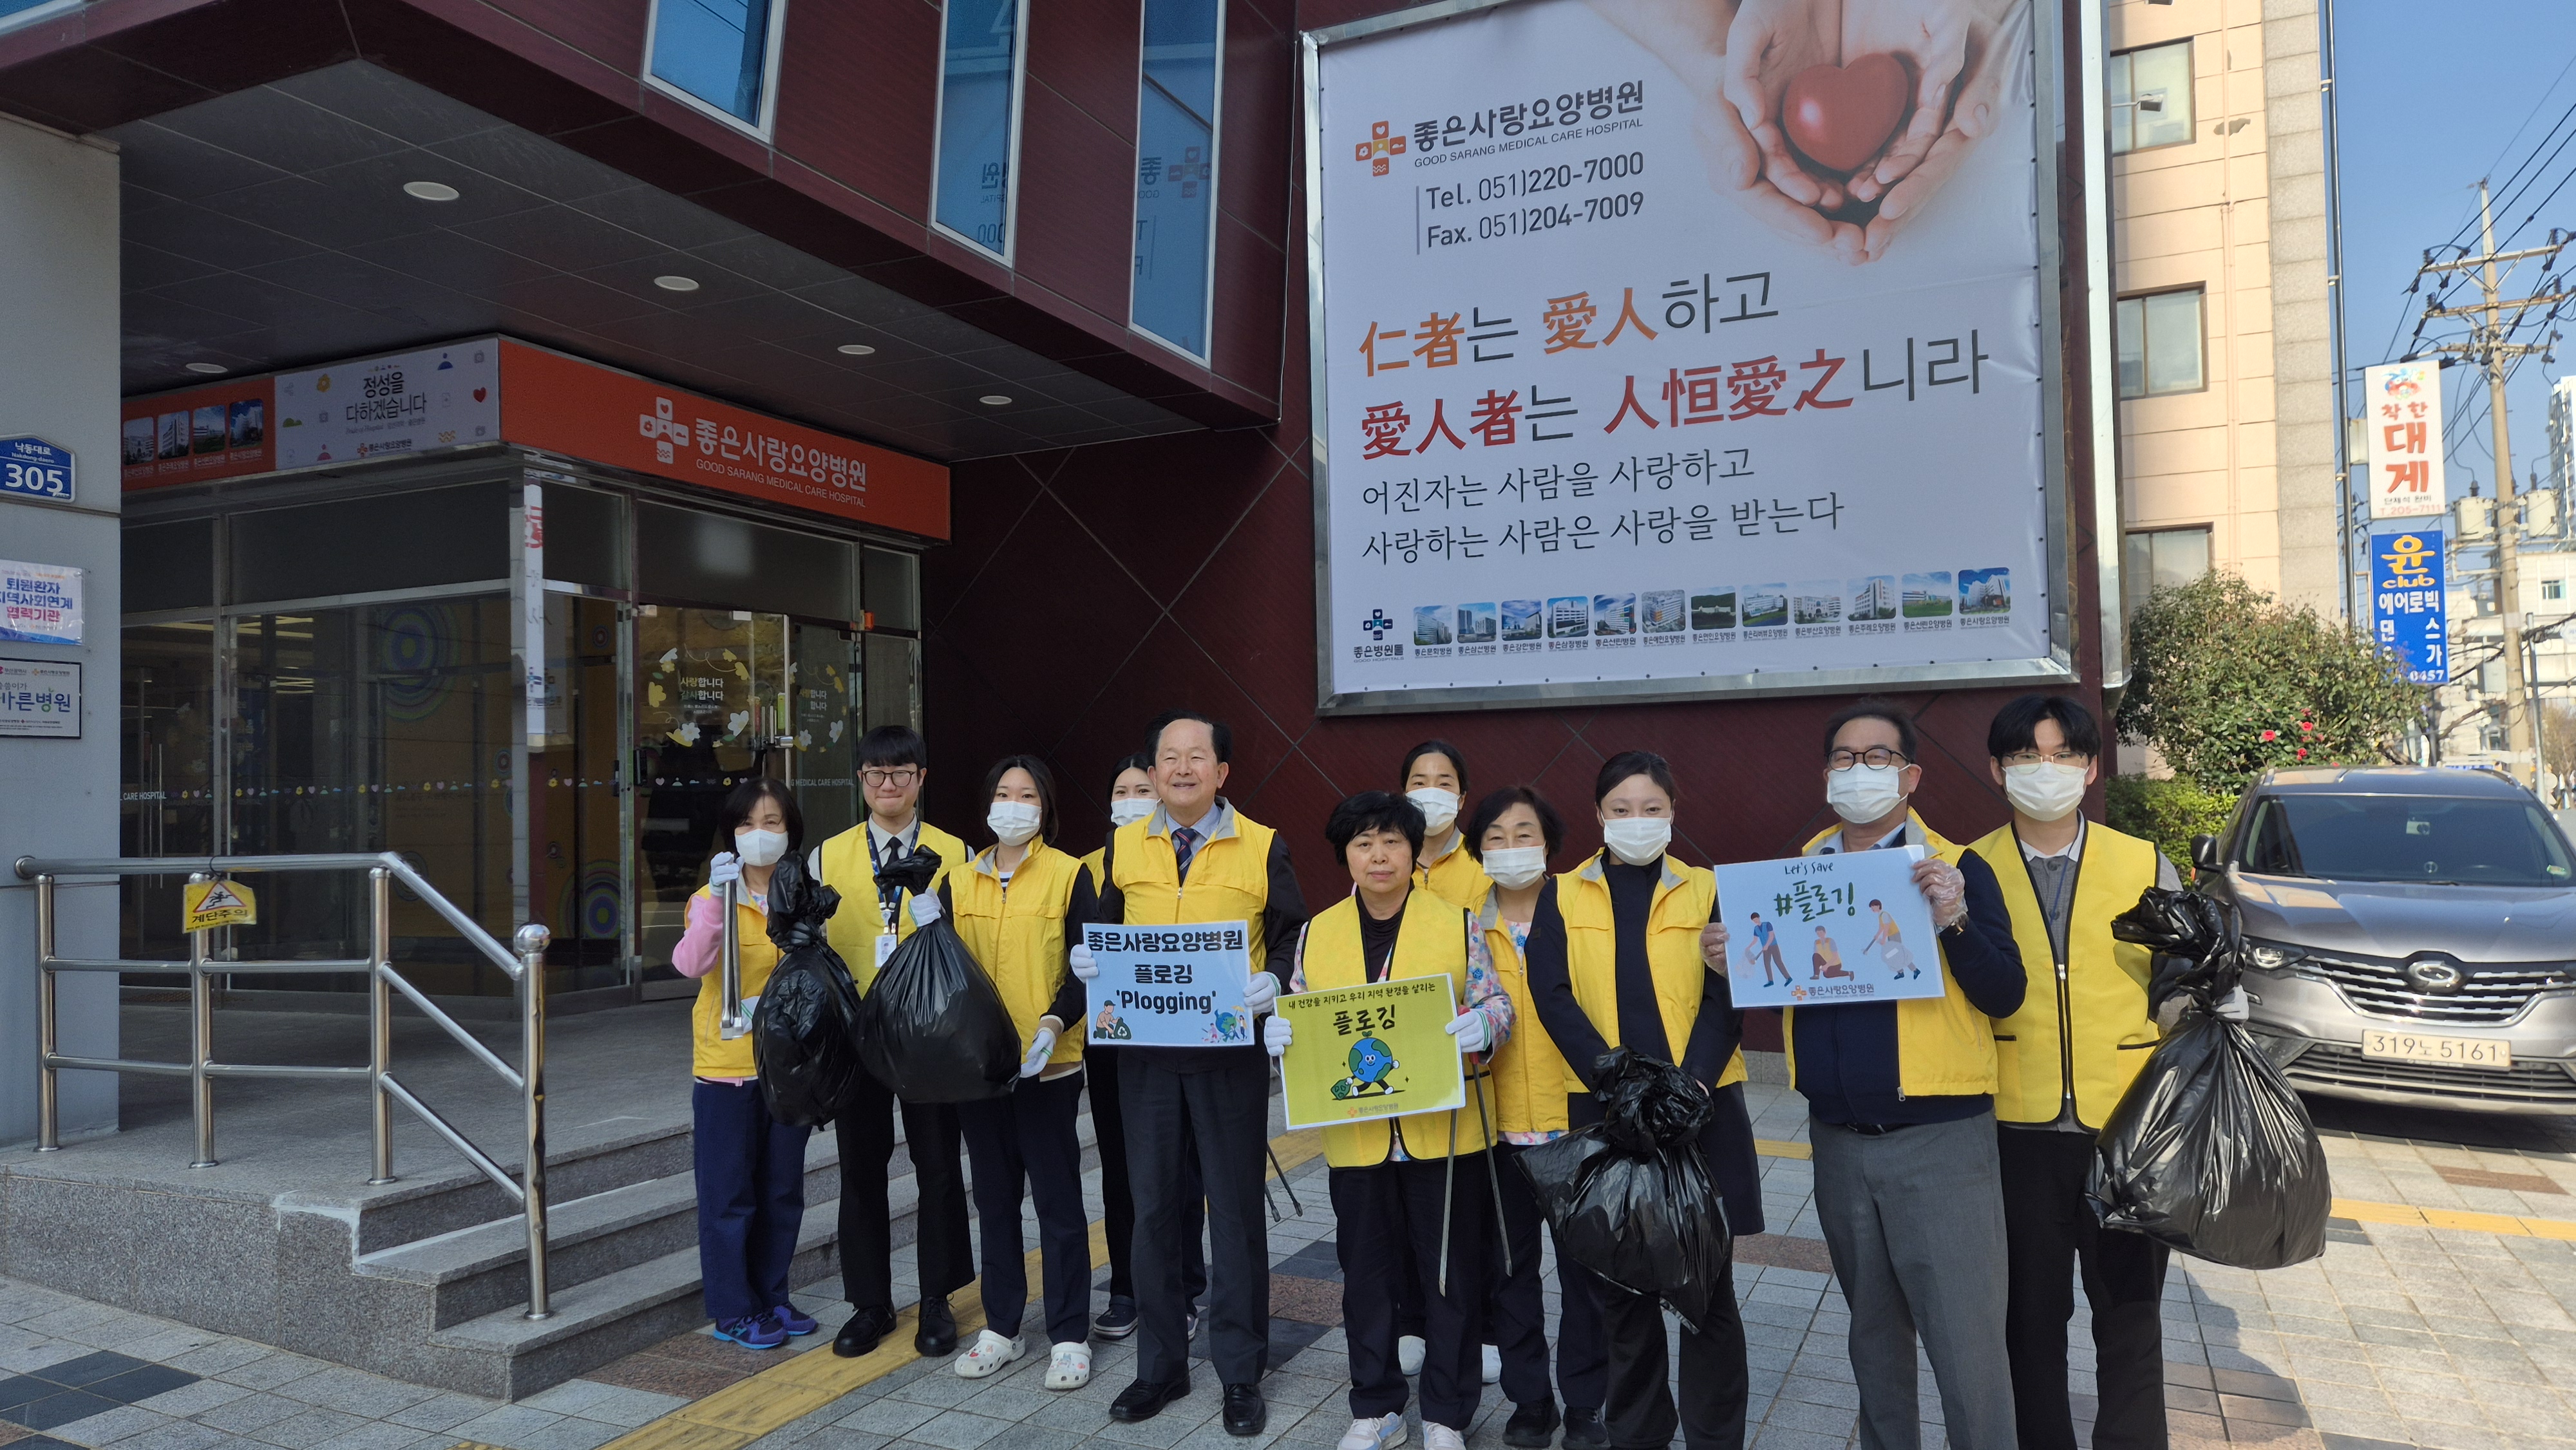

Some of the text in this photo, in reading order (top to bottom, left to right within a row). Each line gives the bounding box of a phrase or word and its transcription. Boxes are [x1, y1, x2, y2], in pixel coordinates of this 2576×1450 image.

[1414, 79, 1643, 152] 좋은사랑요양병원
[1414, 118, 1643, 167] GOOD SARANG MEDICAL CARE HOSPITAL
[1426, 152, 1643, 210] Tel. 051)220-7000
[1428, 192, 1644, 247] Fax. 051)204-7009
[1359, 271, 1779, 377] 仁者는 愛人하고
[363, 372, 404, 398] 정성을
[1361, 329, 1989, 460] 愛人者는 人恒愛之니라
[346, 392, 428, 423] 다하겠습니다
[12, 453, 54, 463] Nakdong-daero
[15, 442, 52, 455] 낙동대로
[696, 418, 866, 491] 좋은사랑요양병원
[2383, 422, 2429, 493] 대게
[5, 464, 63, 493] 305
[696, 458, 866, 508] GOOD SARANG MEDICAL CARE HOSPITAL
[1363, 448, 1755, 515] 어진자는 사람을 사랑하고
[1363, 491, 1845, 565] 사랑하는 사람은 사랑을 받는다
[2381, 535, 2435, 574] 윤
[6, 578, 61, 594] 퇴원환자
[2382, 574, 2435, 588] club
[6, 606, 61, 622] 협력기관
[2379, 590, 2439, 616] 에어로빅
[1960, 616, 2009, 626] 좋은사랑요양병원
[1354, 644, 1403, 657] 좋은병원들
[1415, 647, 1452, 657] 좋은문화병원
[1458, 645, 1496, 654] 좋은삼선병원
[1548, 640, 1589, 650] 좋은삼정병원
[1595, 637, 1636, 647] 좋은선린병원
[681, 677, 724, 688] 사랑합니다
[123, 791, 167, 800] CARE HOSPITAL
[1785, 863, 1808, 876] Let's
[1774, 880, 1855, 923] #플로깅
[193, 909, 247, 923] 계단주의
[1088, 929, 1244, 952] 좋은사랑요양병원
[1134, 964, 1193, 984] 플로깅
[1116, 990, 1217, 1014] 'Plogging'
[1289, 983, 1435, 1010] 내 건강을 지키고 우리 지역 환경을 살리는
[1808, 983, 1875, 996] 좋은사랑요양병원
[1332, 1004, 1395, 1036] 플로깅
